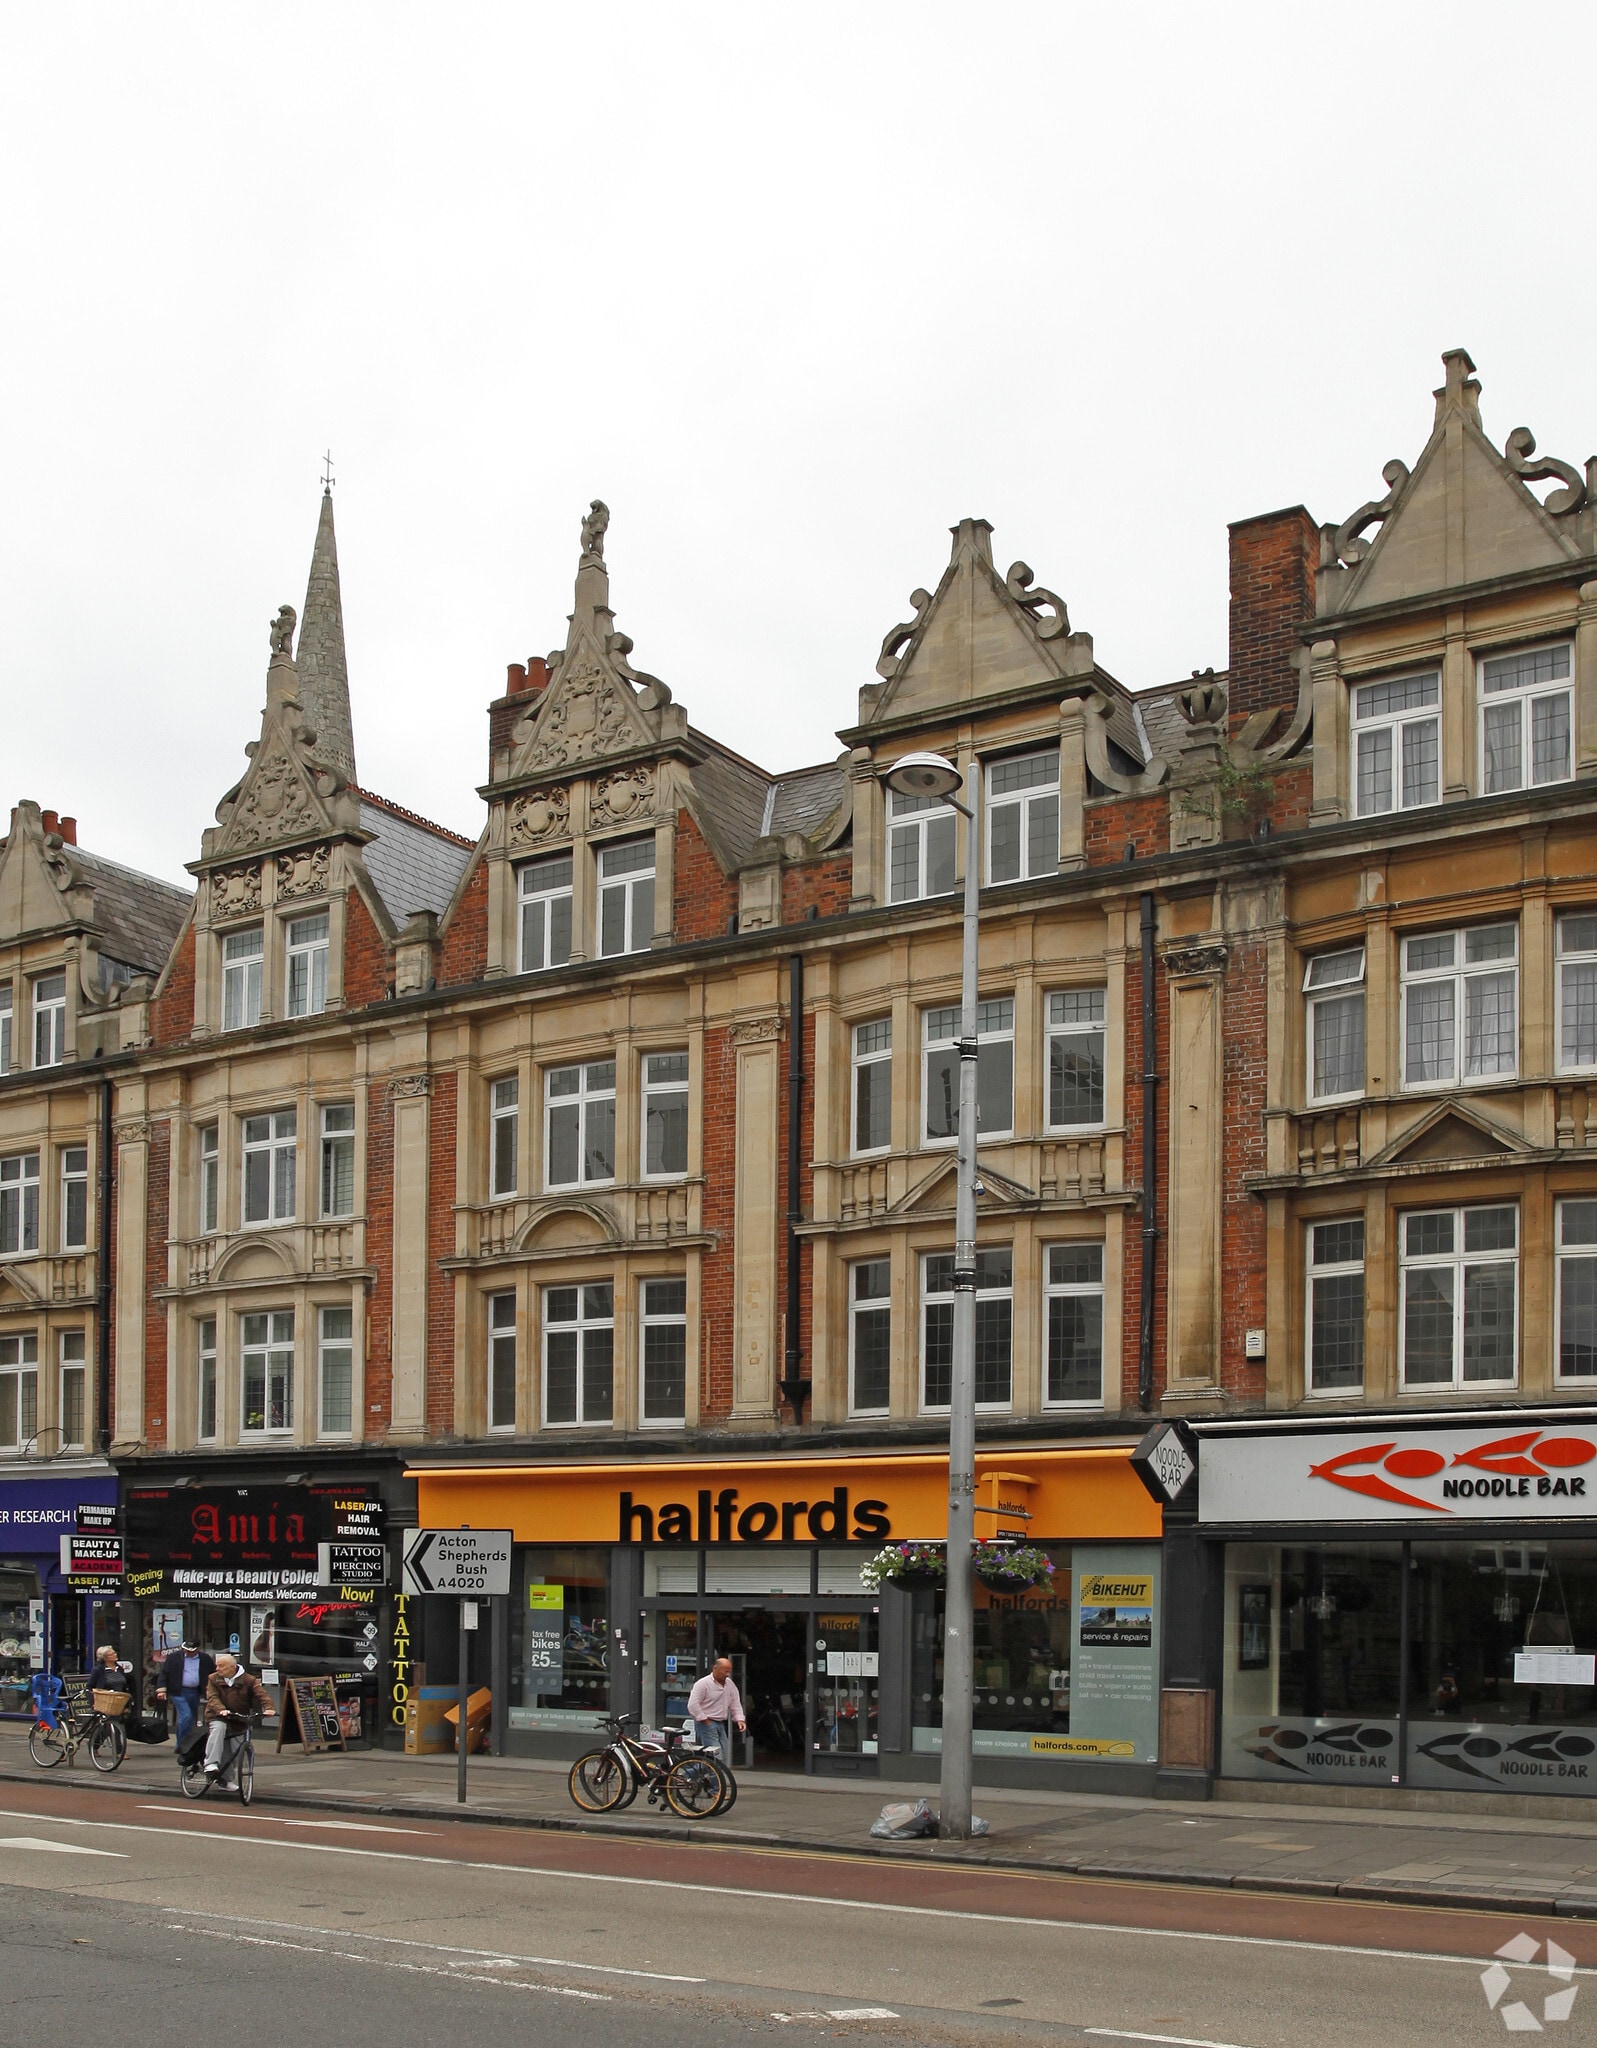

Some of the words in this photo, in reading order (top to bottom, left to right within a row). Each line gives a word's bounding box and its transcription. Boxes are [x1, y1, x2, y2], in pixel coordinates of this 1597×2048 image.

[1155, 1447, 1186, 1468] NOODLE
[1161, 1466, 1183, 1488] BAR
[1443, 1478, 1529, 1498] NOODLE
[1537, 1477, 1585, 1497] BAR
[79, 1505, 116, 1515] PERMANENT
[998, 1501, 1027, 1513] halfords
[13, 1510, 70, 1523] RESEARCH
[347, 1514, 370, 1523] HAIR
[619, 1486, 891, 1542] halfords
[83, 1516, 101, 1525] MAKE
[103, 1518, 112, 1526] UP
[191, 1502, 304, 1544] Amia
[337, 1526, 380, 1536] REMOVAL
[73, 1540, 111, 1549] BEAUTY
[113, 1541, 120, 1549] &
[438, 1536, 476, 1547] Acton
[75, 1550, 118, 1558] MAKE-UP
[332, 1547, 381, 1556] TATTOO
[438, 1550, 507, 1562] Shepherds
[74, 1562, 120, 1570] ACADEMY
[333, 1562, 381, 1570] PIERCING
[456, 1564, 487, 1574] Bush
[68, 1577, 99, 1585] LASER
[127, 1569, 163, 1584] Opening
[173, 1569, 222, 1586] Make-up
[225, 1570, 234, 1584] &
[236, 1569, 279, 1587] Beauty
[281, 1569, 319, 1586] Colleg
[437, 1578, 484, 1588] A4020
[134, 1582, 160, 1597] Soon!
[180, 1588, 232, 1600] International
[234, 1588, 273, 1600] Students
[275, 1588, 317, 1600] Welcome
[341, 1586, 374, 1603] Now!
[1092, 1584, 1147, 1596] BIKEHUT
[990, 1595, 1070, 1611] halfords
[532, 1630, 543, 1638] tax
[545, 1630, 560, 1639] free
[1082, 1633, 1111, 1641] service
[1113, 1633, 1119, 1641] &
[1121, 1633, 1149, 1642] repairs
[532, 1638, 560, 1649] bikes
[393, 1594, 410, 1726] TATTOO
[532, 1651, 550, 1667] £5
[1132, 1682, 1152, 1690] audio
[1034, 1740, 1098, 1751] halfords.com
[1306, 1753, 1355, 1767] NOODLE
[1359, 1755, 1387, 1768] BAR
[1500, 1761, 1553, 1776] NOODLE
[1558, 1762, 1588, 1778] BAR
